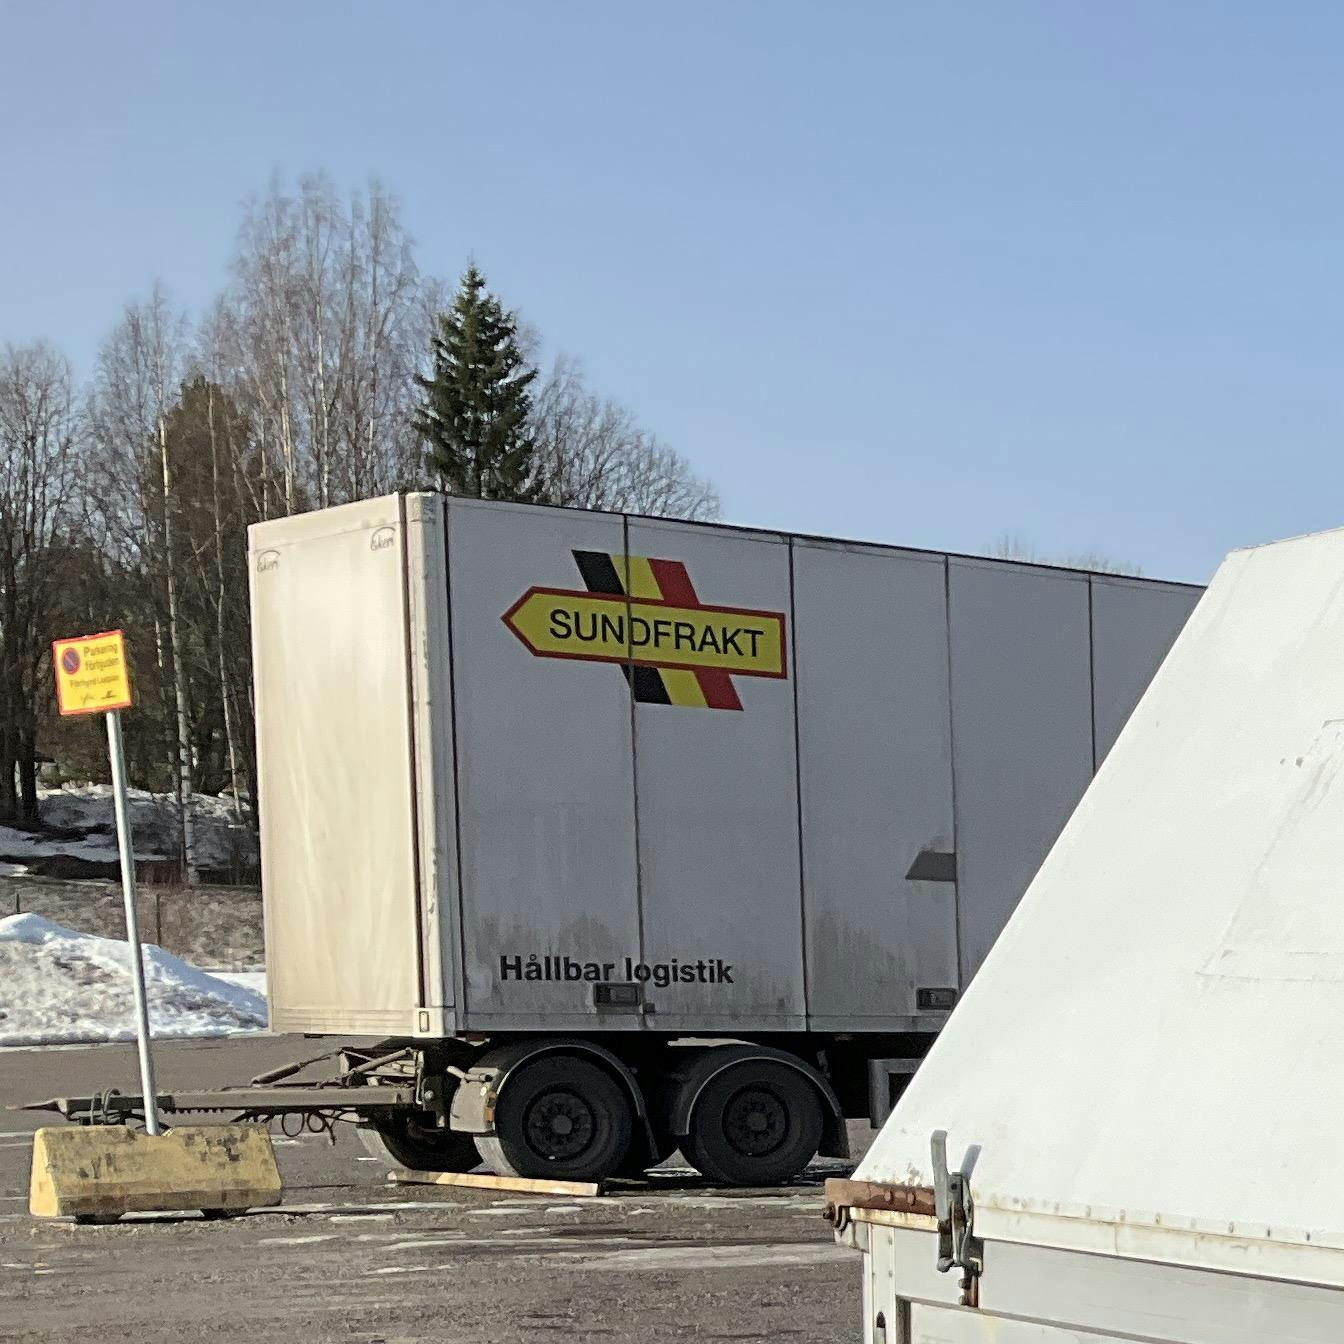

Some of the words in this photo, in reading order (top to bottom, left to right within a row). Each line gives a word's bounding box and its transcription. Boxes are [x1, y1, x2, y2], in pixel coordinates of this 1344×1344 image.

[549, 608, 764, 658] SUNDFRAKT
[500, 954, 615, 982] Hållbar
[625, 957, 735, 988] logistik
